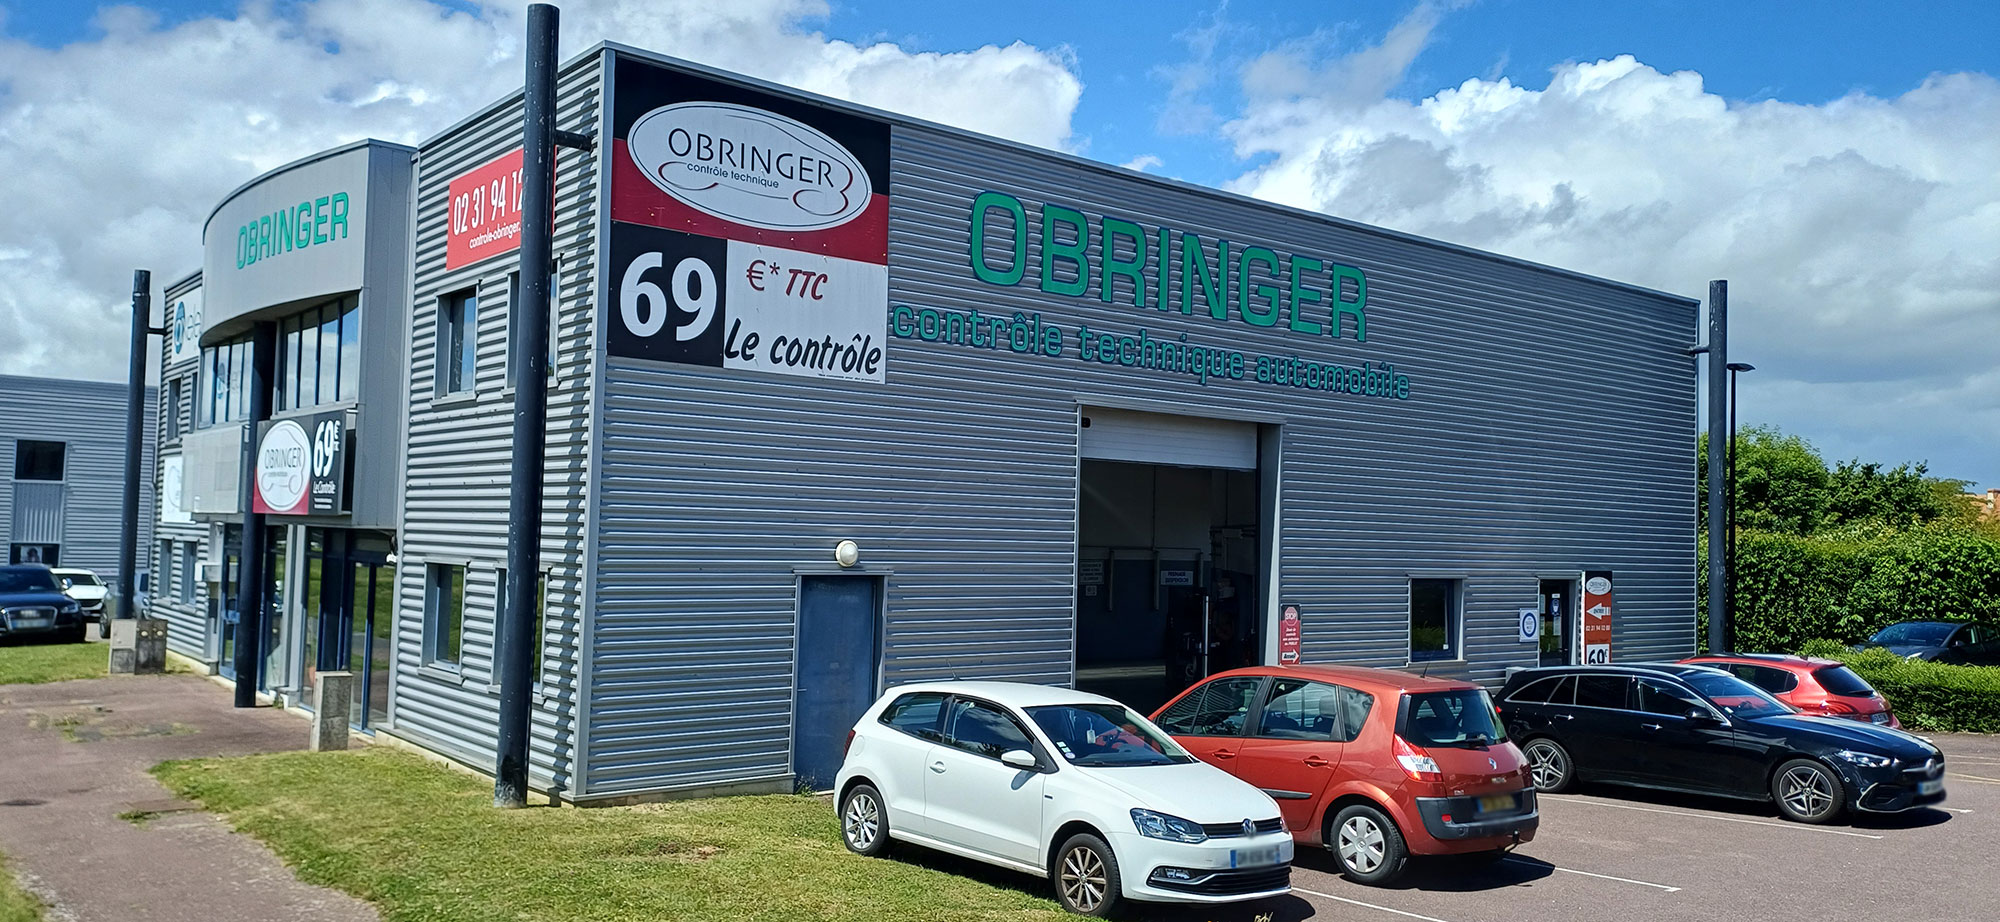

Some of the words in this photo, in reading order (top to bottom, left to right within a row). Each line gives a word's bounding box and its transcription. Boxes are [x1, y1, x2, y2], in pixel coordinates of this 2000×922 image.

[668, 127, 834, 188] OBRINGER
[687, 162, 729, 178] contrôle
[731, 170, 779, 189] technique
[236, 191, 349, 270] OBRINGER
[453, 192, 469, 236] 02
[471, 185, 485, 229] 31
[491, 175, 506, 221] 94
[469, 221, 521, 249] controle-obringer.
[620, 251, 717, 341] 69
[786, 268, 828, 300] TTC
[970, 190, 1367, 343] OBRINGER
[725, 318, 760, 361] Le
[769, 333, 882, 375] contrôle
[892, 305, 1063, 357] contrôle
[1079, 324, 1245, 385] technique
[1256, 354, 1410, 400] automobile
[264, 447, 302, 469] OBRINGER
